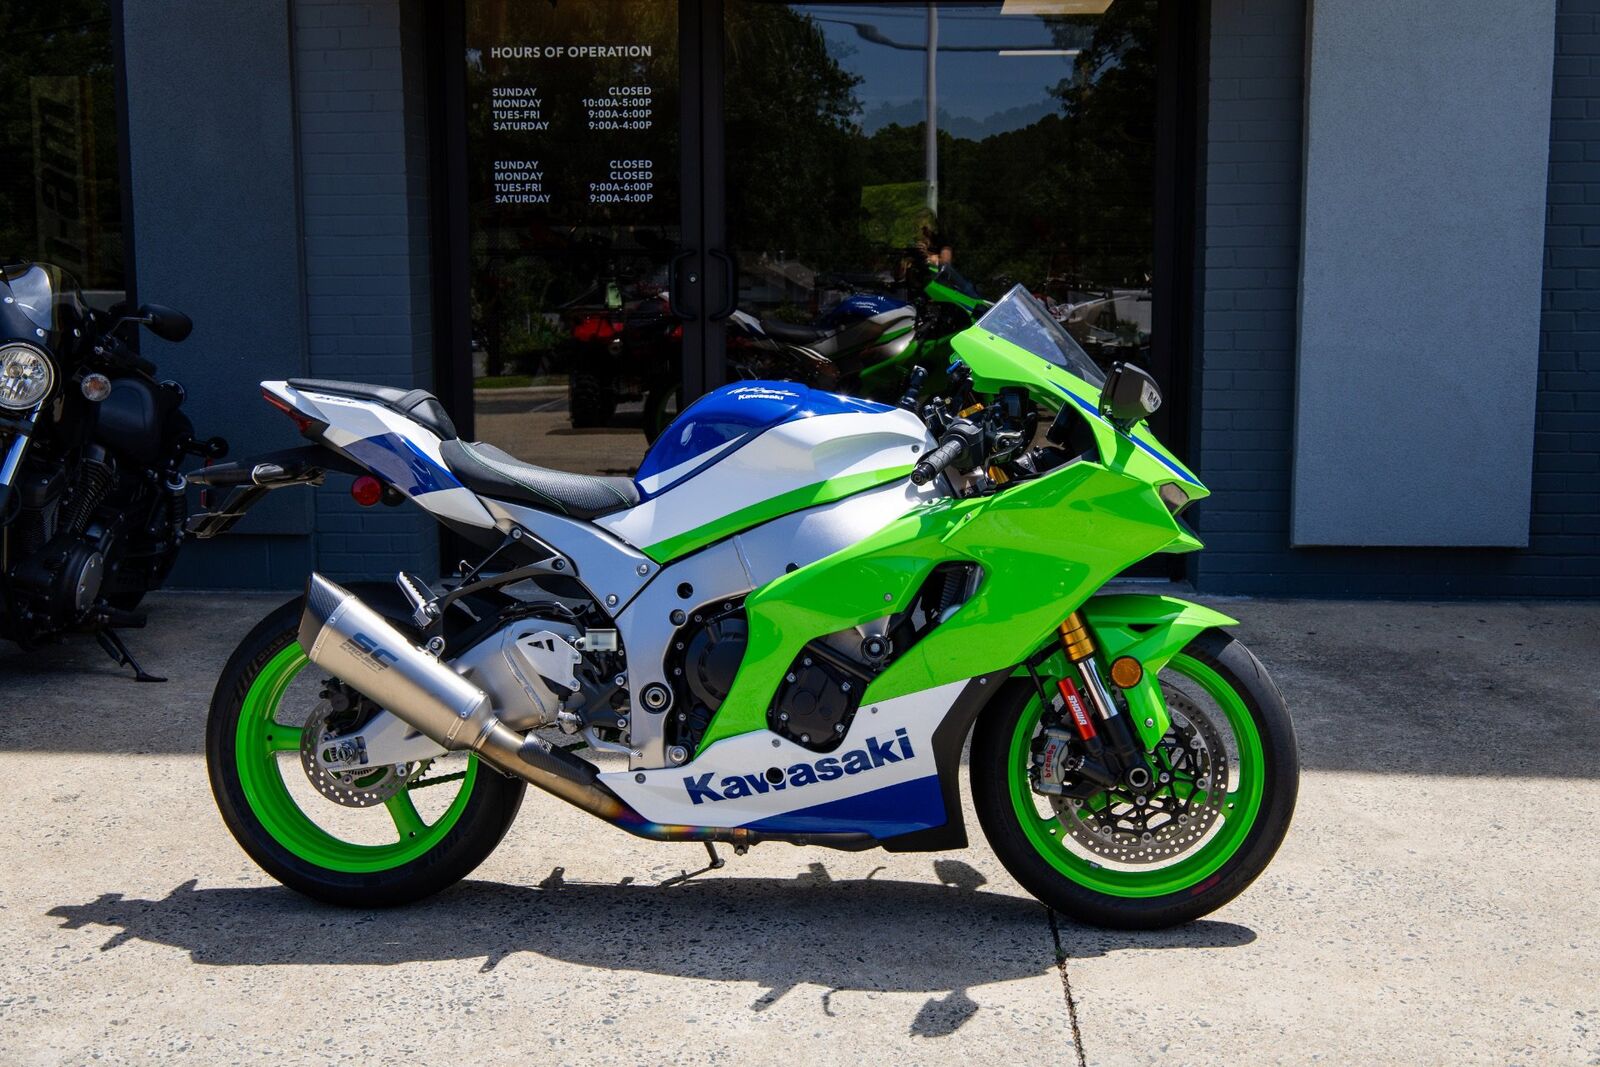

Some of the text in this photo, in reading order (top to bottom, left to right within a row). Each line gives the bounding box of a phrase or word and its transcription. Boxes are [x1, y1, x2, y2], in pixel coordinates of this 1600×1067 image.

[492, 46, 651, 58] HOURS OF OPERATION
[492, 86, 652, 97] SUNDAY CLOSED
[492, 97, 652, 108] MONDAY 10:00A-5:00P
[492, 109, 652, 120] TUES-FRI 9:00A-6:00P
[493, 120, 652, 131] SATURDAY 9:00A-4:00P
[494, 159, 653, 170] SUNDAY CLOSED
[494, 171, 653, 181] MONDAY CLOSED
[494, 182, 653, 192] TUES-FRI 9:00A-6:00P
[495, 193, 654, 204] SATURDAY 9:00A-4:00P
[346, 632, 399, 669] SC
[1067, 694, 1087, 725] SHOWA
[682, 727, 915, 805] Kawasaki
[1044, 744, 1056, 778] brembo
